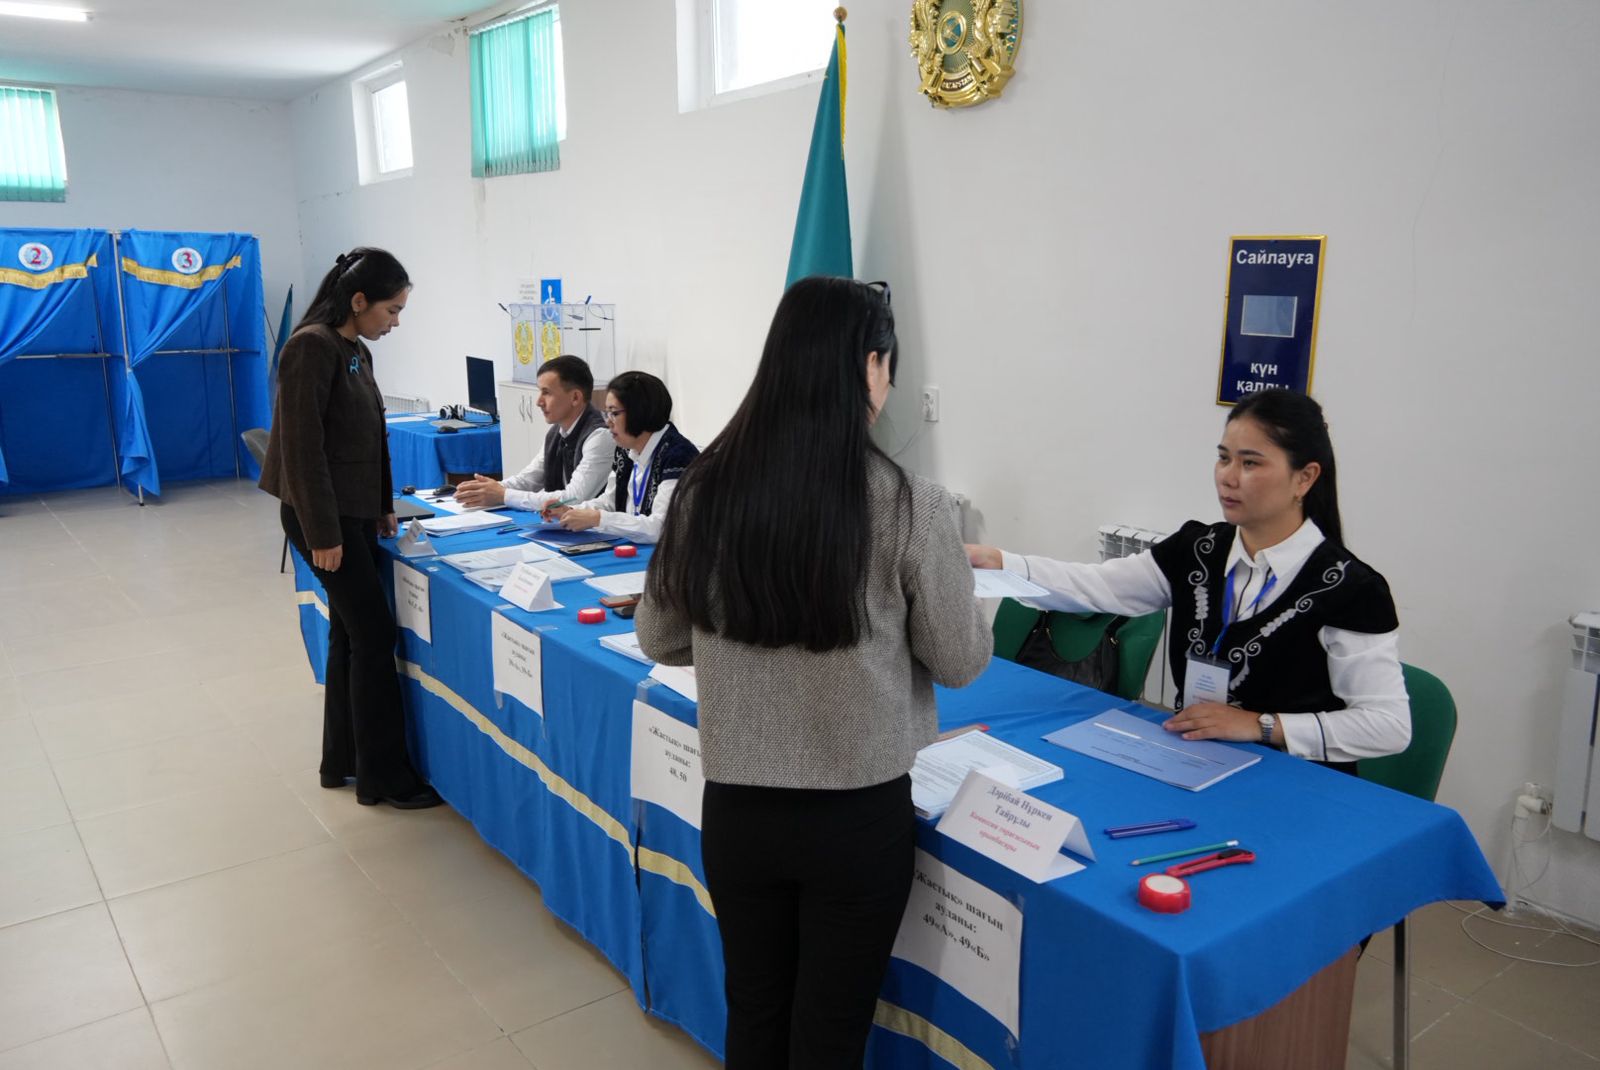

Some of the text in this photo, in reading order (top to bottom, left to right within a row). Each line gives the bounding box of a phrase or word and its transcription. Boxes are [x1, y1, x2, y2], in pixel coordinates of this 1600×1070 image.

[31, 246, 42, 265] 2
[182, 251, 193, 268] 3
[1236, 249, 1314, 268] Сайлауға
[1250, 362, 1278, 378] күн
[1236, 380, 1290, 393] қал
